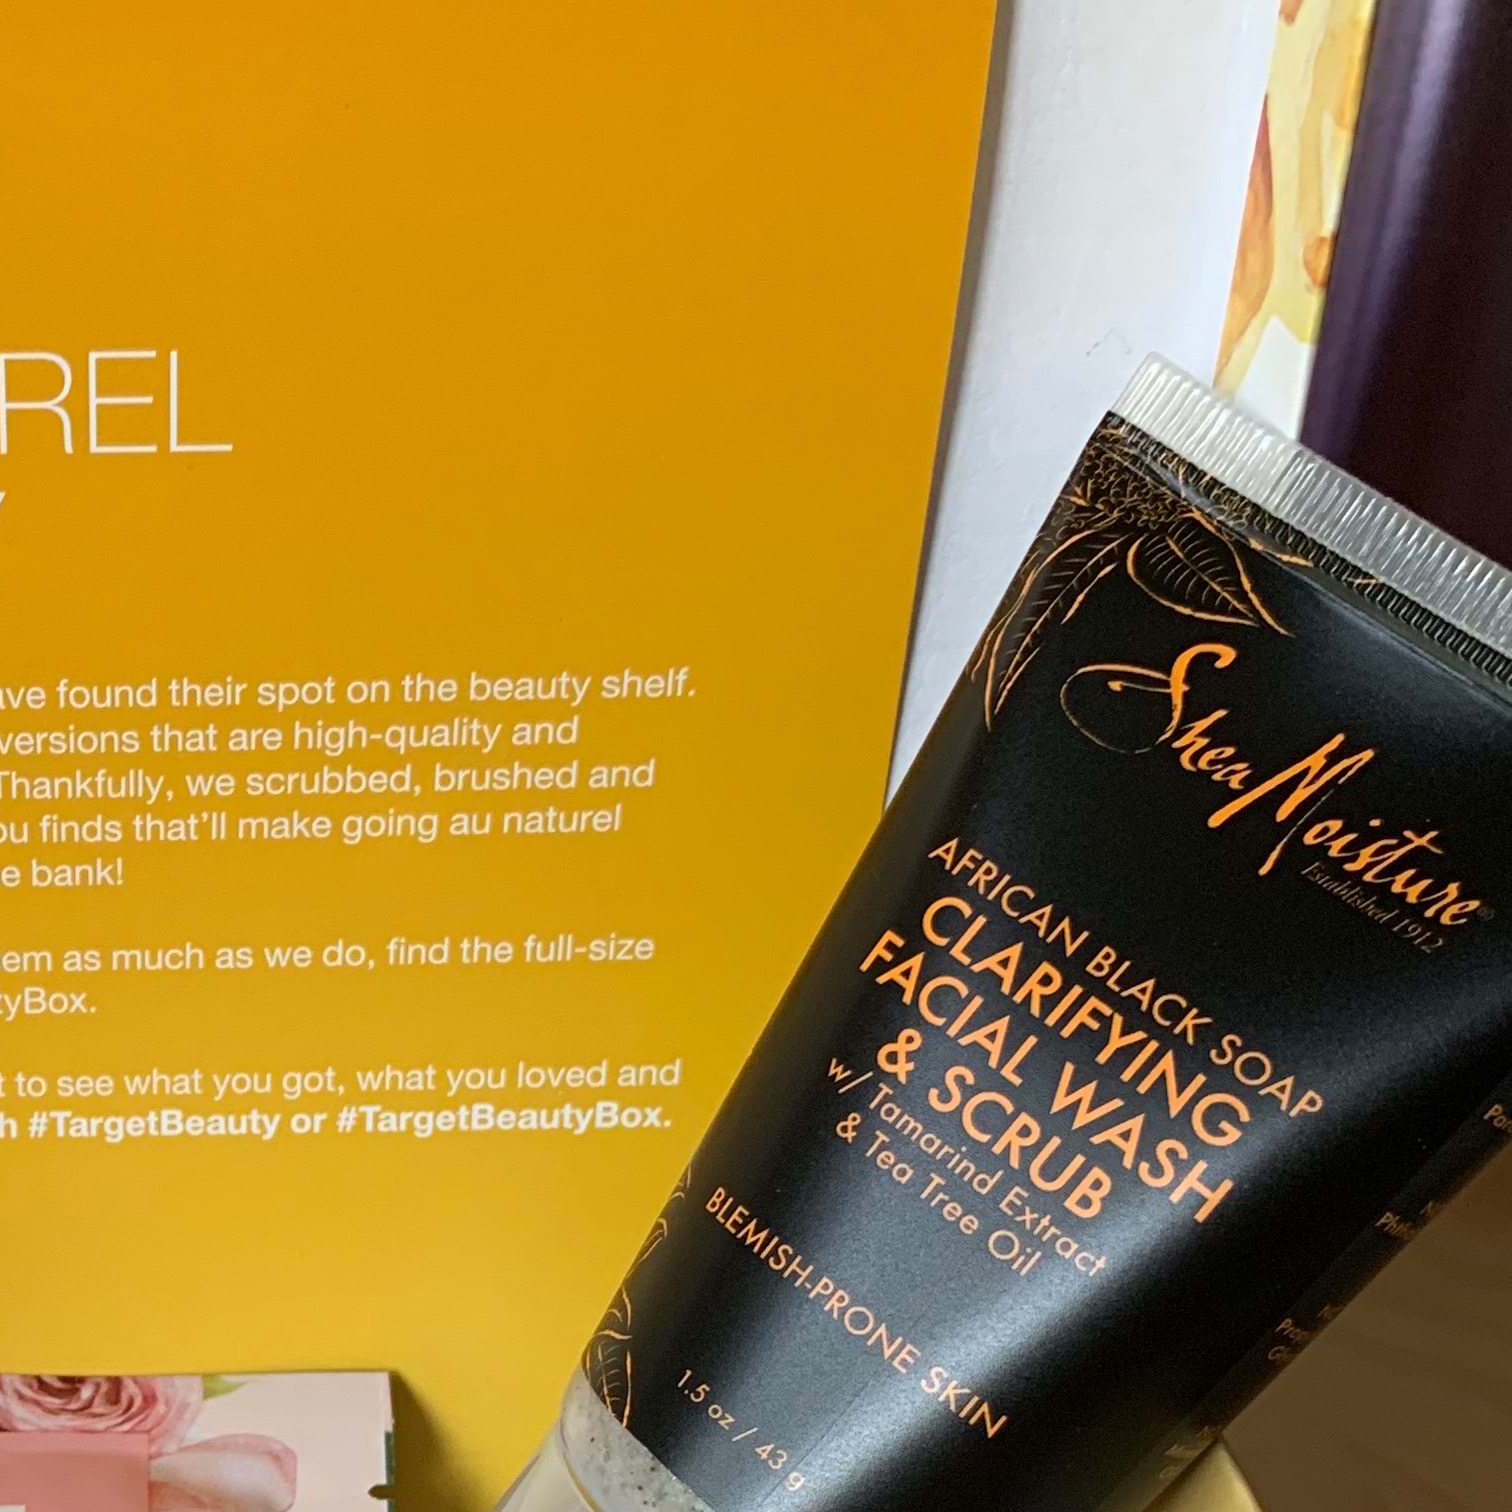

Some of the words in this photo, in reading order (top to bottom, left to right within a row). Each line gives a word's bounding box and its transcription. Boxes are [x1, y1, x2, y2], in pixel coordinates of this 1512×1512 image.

[56, 677, 158, 709] found
[168, 675, 248, 706] their
[257, 675, 336, 712] spot
[346, 678, 391, 704] on
[401, 672, 459, 702] the
[469, 670, 592, 706] beauty
[601, 666, 695, 699] shelf.
[150, 723, 218, 752] that
[228, 728, 284, 751] are
[294, 718, 503, 756] high-quality
[512, 714, 580, 745] and
[185, 773, 237, 797] we
[246, 764, 422, 796] scrubbed,
[434, 760, 579, 792] brushed
[588, 757, 656, 788] and
[31, 857, 123, 888] bank!
[1300, 860, 1390, 924] Established
[1392, 916, 1447, 954] 1912
[922, 896, 1251, 1148] CLARIFYING
[928, 837, 1089, 958] AFRICAN
[1085, 945, 1213, 1047] BLACK
[1209, 1033, 1324, 1120] SOAP
[28, 1109, 281, 1144] #TargetBeauty
[290, 1112, 328, 1135] or
[336, 1102, 672, 1139] #TargetBeautyBox.
[858, 929, 1039, 1086] FACIAL
[1049, 1062, 1234, 1224] WASH
[876, 1028, 923, 1086] &
[927, 1064, 1113, 1219] SCRUB
[827, 1057, 874, 1095] w/
[868, 1081, 1004, 1197] Tamarind
[999, 1179, 1107, 1278] Extract
[835, 1113, 862, 1145] &
[865, 1130, 914, 1186] Tea
[916, 1173, 980, 1236] Tree
[987, 1229, 1043, 1279] Oil
[705, 1186, 921, 1374] BLEMISH-PRONE
[920, 1365, 1009, 1438] SKIN
[677, 1368, 710, 1404] 1.5
[707, 1403, 736, 1432] oz
[754, 1441, 788, 1471] 43
[786, 1471, 806, 1492] g
